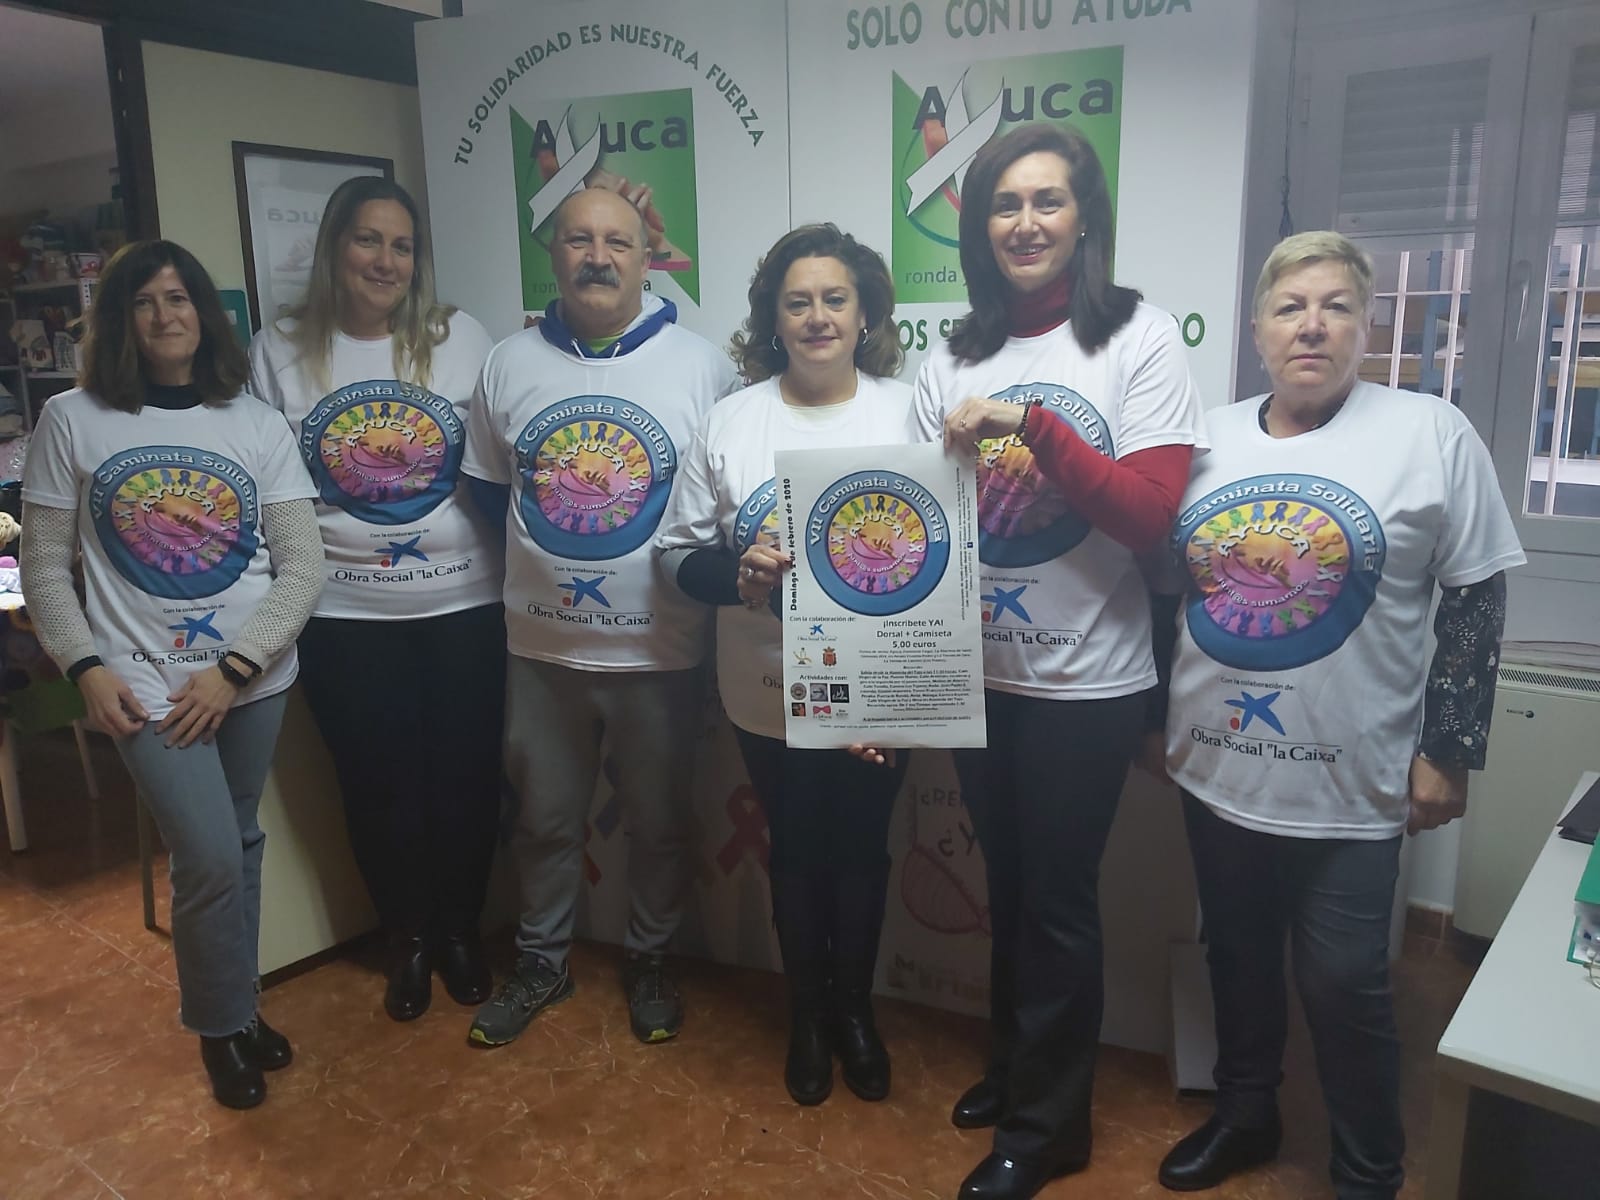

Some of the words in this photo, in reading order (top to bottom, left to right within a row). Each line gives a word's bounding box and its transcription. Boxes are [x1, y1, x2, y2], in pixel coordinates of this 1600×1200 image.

[847, 1, 922, 50] SOLO
[454, 136, 474, 165] TU
[468, 31, 572, 134] SOLIDARIDAD
[580, 24, 601, 44] ES
[611, 24, 699, 70] NUESTRA
[705, 63, 765, 147] FUERZA
[905, 266, 957, 284] ronda
[308, 386, 394, 426] Caminata
[400, 387, 461, 444] Solidaria
[345, 418, 416, 448] AYUCA
[525, 402, 615, 442] Caminata
[621, 406, 673, 482] Solidaria
[559, 440, 625, 474] AYUCA
[97, 452, 194, 485] Caminata
[201, 455, 257, 523] Solidaria
[140, 486, 216, 517] AYUCA
[580, 489, 624, 510] sumamos
[783, 502, 792, 514] de
[808, 517, 824, 546] VII
[819, 477, 889, 514] Caminata
[893, 479, 945, 544] Solidaria
[785, 516, 795, 548] febrero
[850, 512, 904, 540] AYUCA
[1181, 479, 1300, 527] Caminata
[1307, 483, 1379, 571] Solidaria
[786, 549, 795, 561] de
[1218, 523, 1310, 559] AYUCA
[335, 569, 369, 582] Obra
[373, 572, 413, 583] Social
[416, 569, 433, 579] "la
[435, 558, 472, 576] Caixa"
[789, 571, 799, 611] Domingo
[1252, 580, 1310, 607] sumamos
[528, 603, 553, 619] Obra
[556, 610, 592, 625] Social
[596, 614, 611, 626] "la
[614, 613, 654, 626] Caixa"
[809, 615, 847, 623] colaboración
[883, 619, 927, 629] ¡Inscribete
[877, 630, 903, 638] Dorsal
[912, 630, 952, 638] Camiseta
[892, 641, 911, 650] 5,00
[982, 630, 1012, 643] ocial
[1016, 631, 1033, 644] "la
[1035, 632, 1083, 646] Caixa"
[168, 651, 208, 665] Social
[211, 649, 225, 660] "la
[1240, 680, 1284, 690] colaboración
[1191, 728, 1221, 747] Obra
[1224, 735, 1263, 757] Social
[1267, 743, 1286, 760] "la
[1290, 746, 1343, 763] Caixa"
